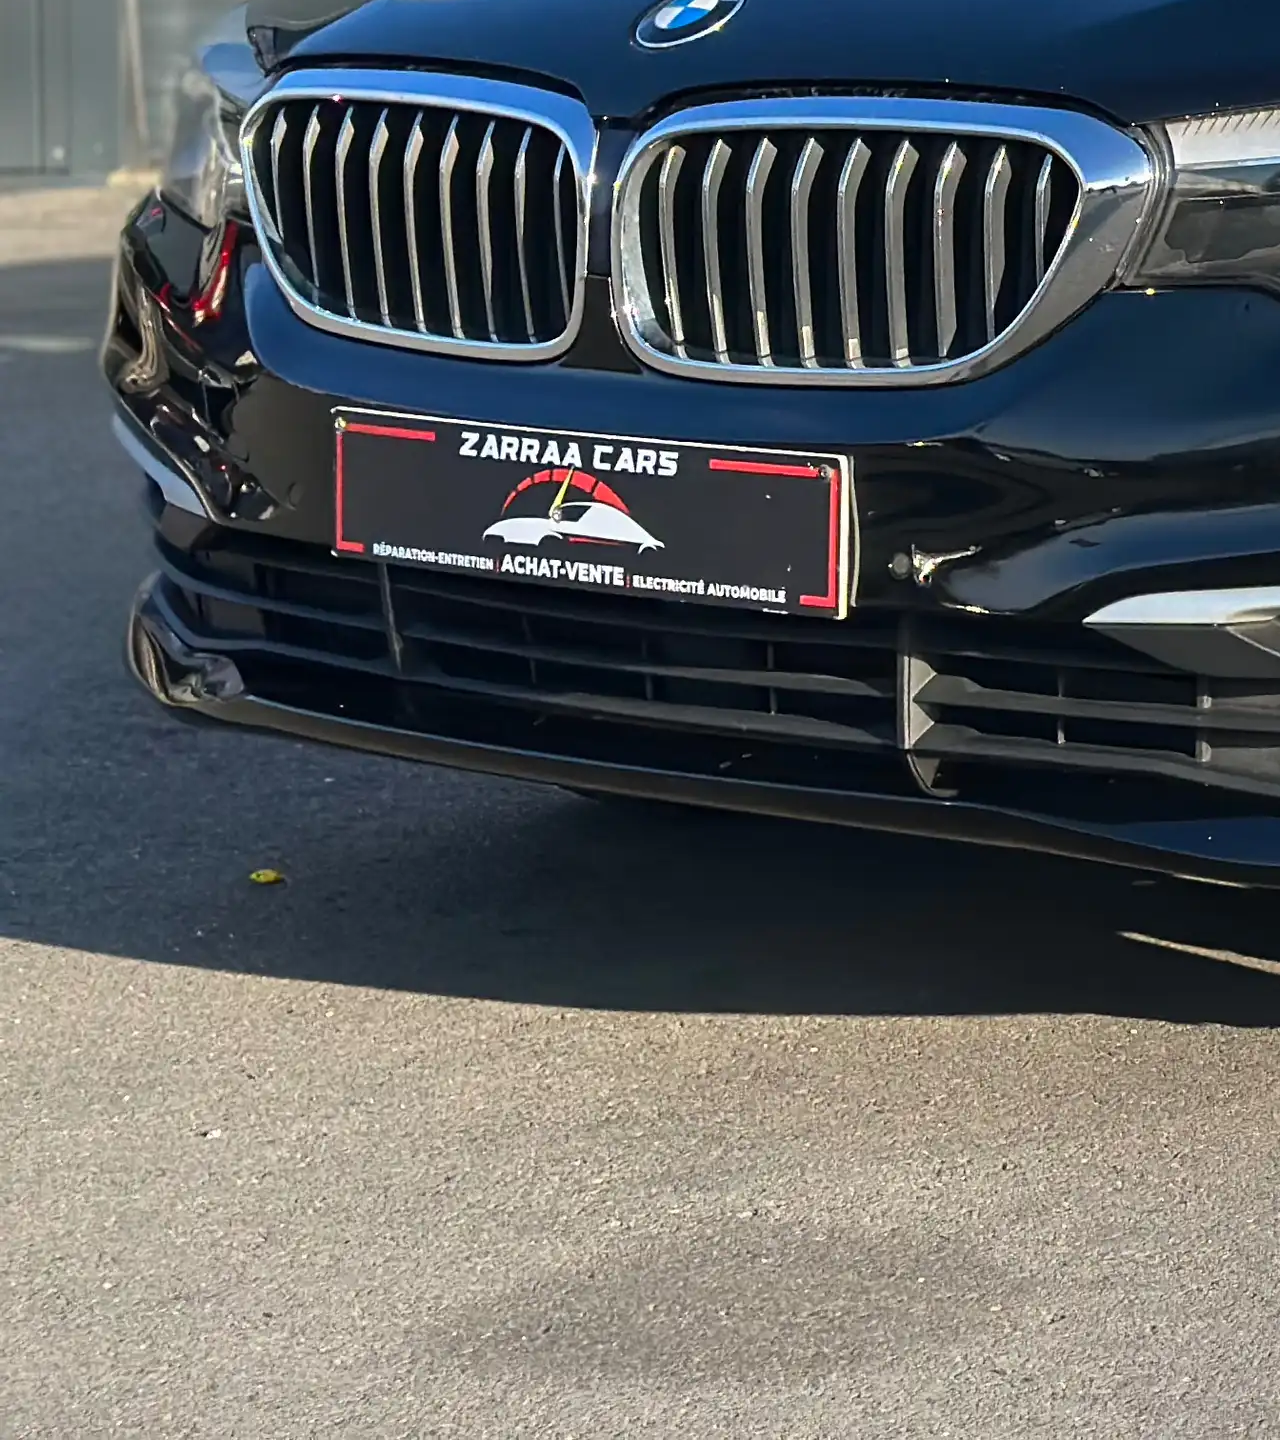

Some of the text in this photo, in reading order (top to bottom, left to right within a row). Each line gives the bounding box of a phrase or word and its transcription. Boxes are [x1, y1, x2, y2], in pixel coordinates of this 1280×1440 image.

[459, 431, 679, 477] ZARRAA CARS
[500, 553, 625, 587] ACHAT-VENTE
